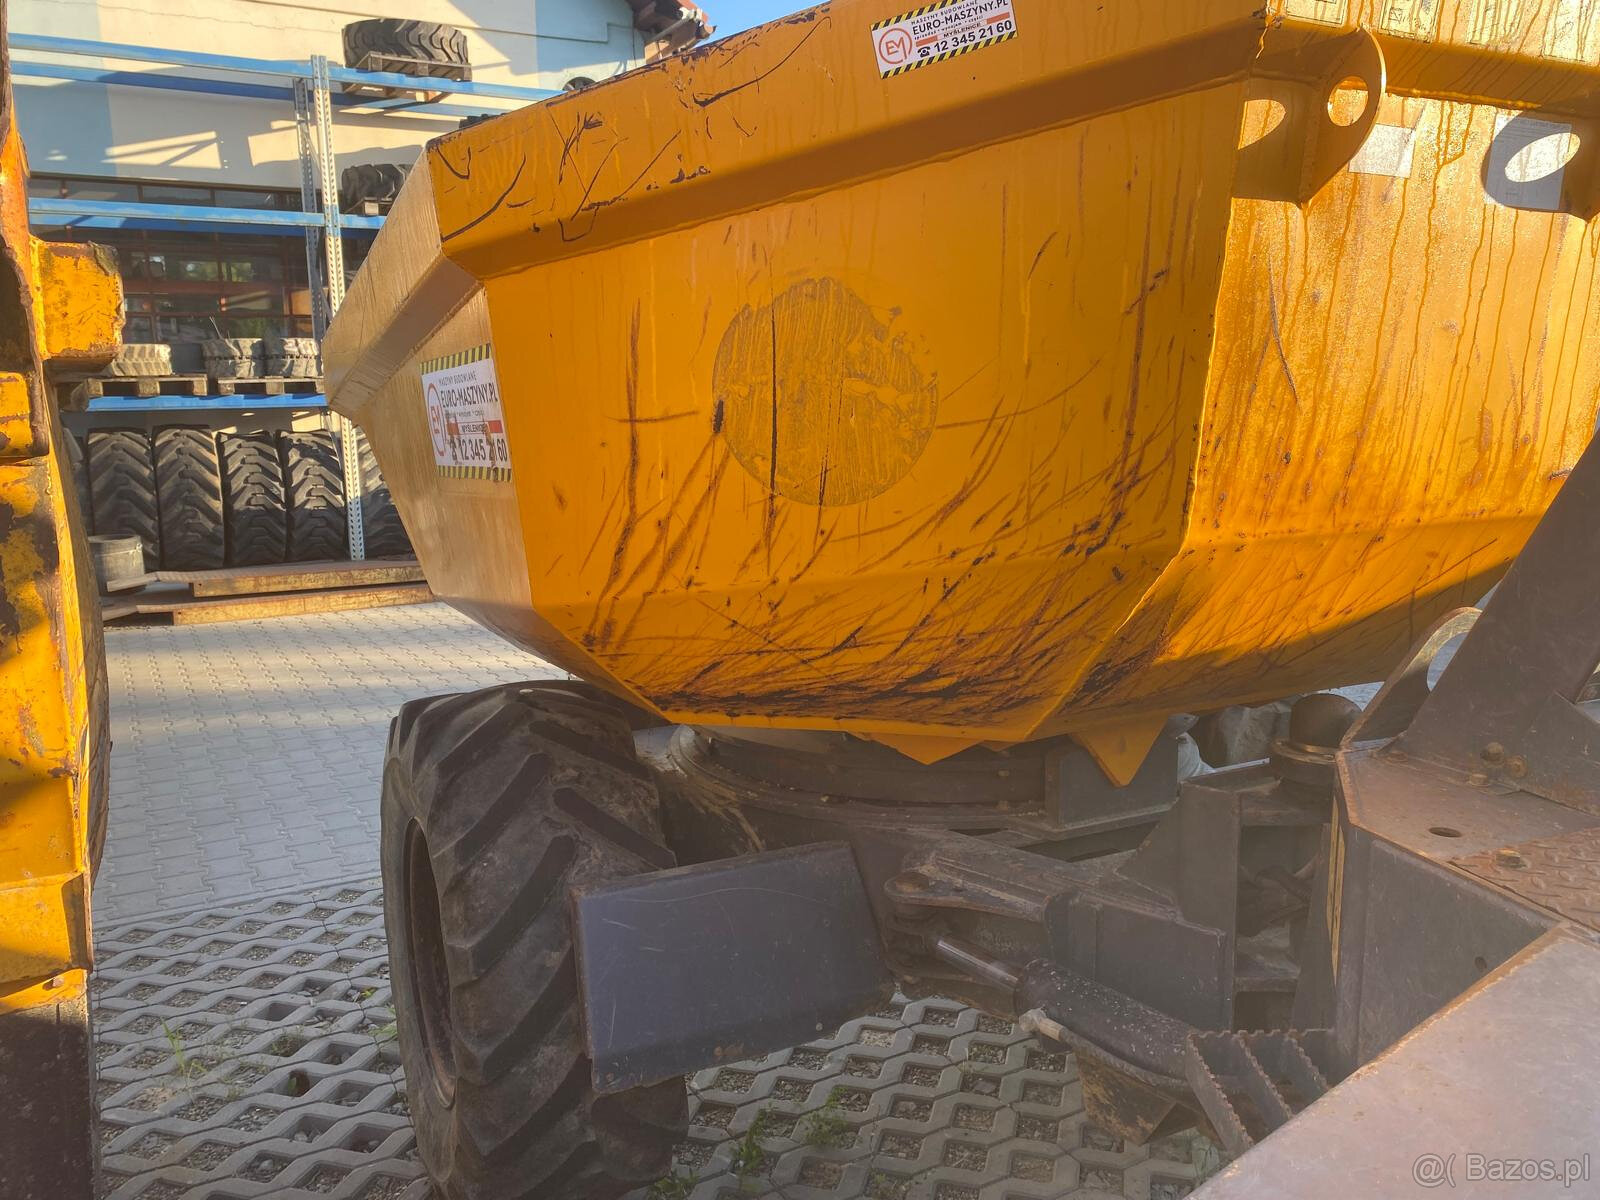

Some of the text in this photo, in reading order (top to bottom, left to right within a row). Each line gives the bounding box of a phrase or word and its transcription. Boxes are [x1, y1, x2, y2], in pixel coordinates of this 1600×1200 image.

[911, 0, 978, 25] MASZYNY BUDOWLANE
[912, 0, 1009, 35] EURO-MASZYNY.PL
[934, 20, 1012, 53] 12 345 21 60
[943, 22, 981, 38] MYŚLENICE
[440, 382, 498, 408] EURO-MASZYNY.PL
[458, 438, 469, 461] 12
[469, 438, 486, 461] 345
[497, 438, 508, 461] 60
